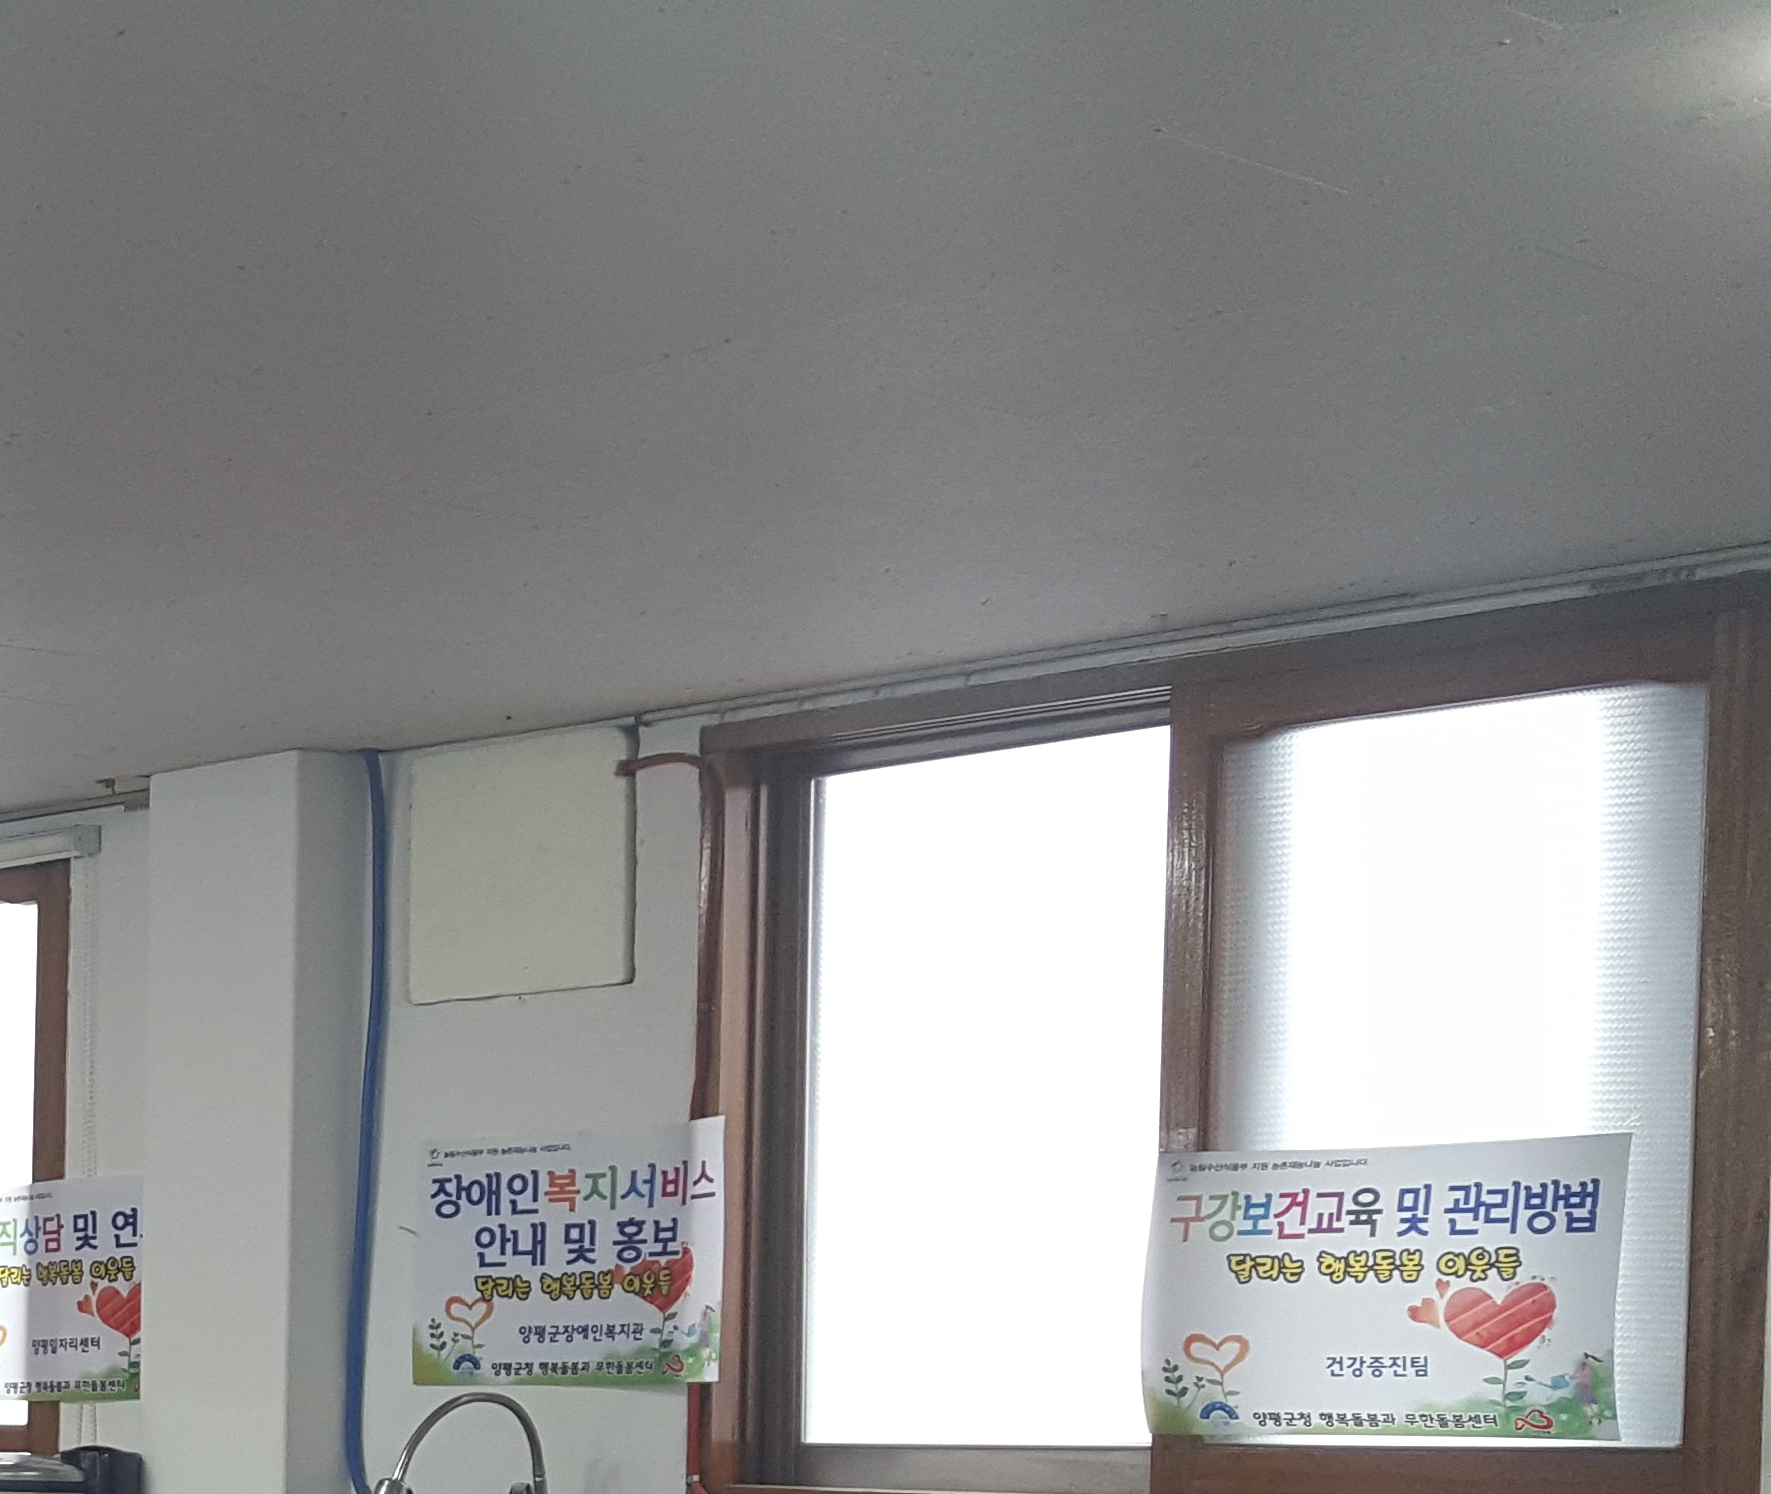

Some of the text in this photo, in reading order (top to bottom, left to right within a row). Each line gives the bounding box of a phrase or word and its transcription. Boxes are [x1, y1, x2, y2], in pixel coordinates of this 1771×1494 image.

[429, 1159, 717, 1219] 장애인복지서비스
[1170, 1177, 1601, 1243] 구강보건교육 및 관리방법
[72, 1209, 99, 1252] 및
[110, 1206, 143, 1250] 연
[474, 1216, 681, 1268] 안내 및 홍보
[35, 1258, 85, 1286] 행복돌봄
[89, 1255, 137, 1283] 이웃들
[1226, 1246, 1523, 1285] 달리는 행복돌봄 이웃들
[474, 1267, 674, 1301] 달리는 행복돌봄 이웃들
[31, 1336, 101, 1355] 양평일자리센터
[518, 1322, 646, 1344] 양평군장애인복지관
[490, 1361, 535, 1377] 양평군청
[538, 1360, 591, 1376] 행복돌봄과
[1325, 1355, 1429, 1378] 건강증진팀
[1252, 1411, 1498, 1430] 양평군청 행복돌봄과 무한돌봄센터
